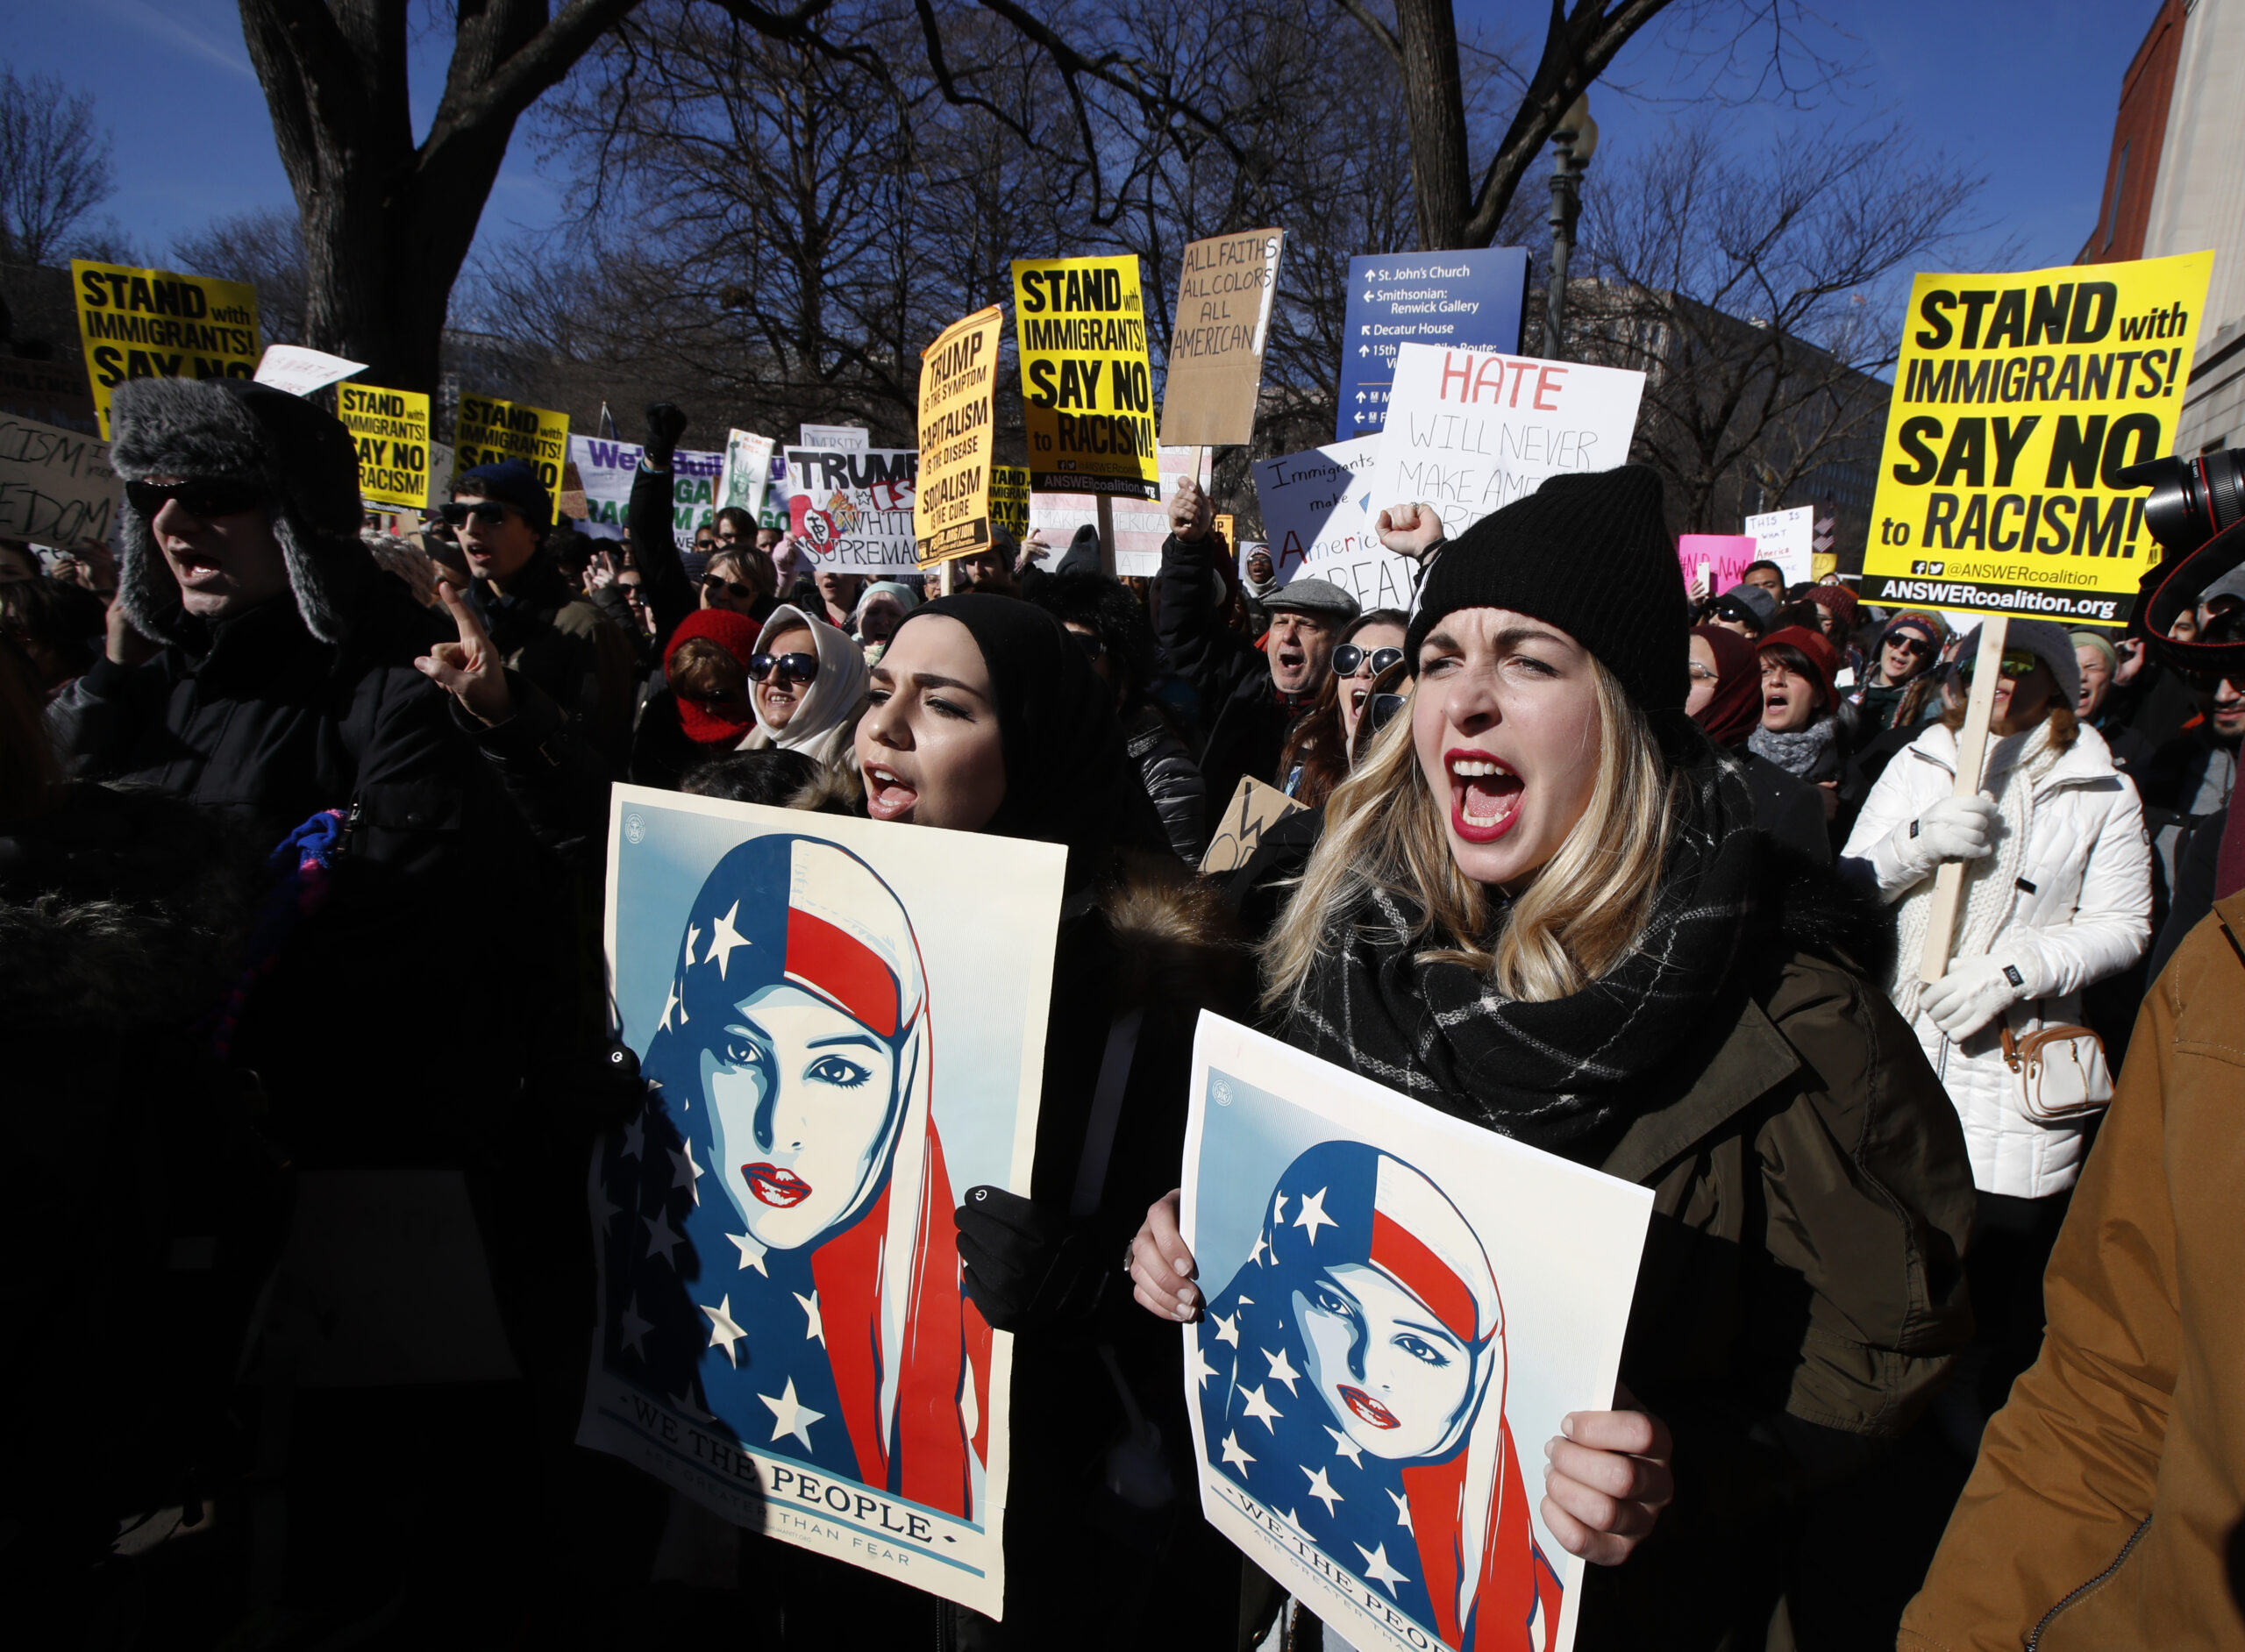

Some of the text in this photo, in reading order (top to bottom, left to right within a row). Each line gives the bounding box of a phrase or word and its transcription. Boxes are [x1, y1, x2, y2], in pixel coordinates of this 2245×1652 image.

[1186, 236, 1277, 274] ALL FAITHS
[1378, 269, 1392, 281] St.
[1429, 265, 1471, 279] Church
[82, 269, 252, 326] STAND with
[1021, 268, 1141, 313] STAND with
[1182, 267, 1272, 301] ALL COLORS
[1376, 288, 1448, 302] Smithsonian:
[1200, 301, 1231, 324] ALL
[1391, 300, 1479, 314] Renwick Gallery
[1915, 281, 2188, 349] STAND with
[86, 310, 257, 357] IMMIGRANTS!
[1024, 317, 1145, 352] IMMIGRANTS!
[1172, 324, 1256, 361] AMERICAN
[1373, 323, 1455, 336] Decatur House
[930, 330, 983, 393] TRUMP
[1372, 345, 1396, 356] 15th
[942, 364, 987, 401] SYMPTOM
[1029, 359, 1149, 413] SAY NO
[1440, 351, 1569, 411] HATE
[1902, 347, 2183, 404] IMMIGRANTS!
[343, 388, 426, 421] STAND with
[463, 398, 564, 441] STAND with
[341, 413, 427, 442] IMMIGRANTS!
[460, 423, 561, 461] IMMIGRANTS!
[921, 395, 988, 456] CAPITALISM
[1034, 431, 1052, 452] to
[1058, 414, 1154, 459] RACISM!
[1410, 411, 1599, 469] WILL NEVER
[352, 436, 387, 466] AY
[392, 441, 424, 472] NO
[944, 435, 979, 465] DISEASE
[1892, 412, 2162, 491] SAY NO
[923, 465, 981, 515] SOCIALISM
[990, 468, 1026, 486] TAND
[1044, 474, 1156, 500] ANSWERcoalition.org
[1267, 453, 1375, 490] Immigrants
[1397, 459, 1475, 503] MAKE
[949, 498, 970, 521] CURE
[1309, 493, 1350, 513] make
[837, 510, 915, 537] WHIT
[1750, 515, 1778, 530] THIS
[1881, 493, 2146, 559] to RACISM!
[1279, 530, 1384, 569] Americ
[1947, 562, 2098, 587] @ANSWERcoalition
[1881, 580, 2118, 619] ANSWERcoalition.org
[632, 1393, 679, 1444] WE
[688, 1428, 757, 1483] THE
[771, 1465, 934, 1543] PEOPLE
[684, 1469, 768, 1518] GREATER
[779, 1512, 839, 1541] THAN
[852, 1536, 910, 1566] FEAR
[1237, 1492, 1284, 1540] WE
[1293, 1536, 1353, 1593] THE
